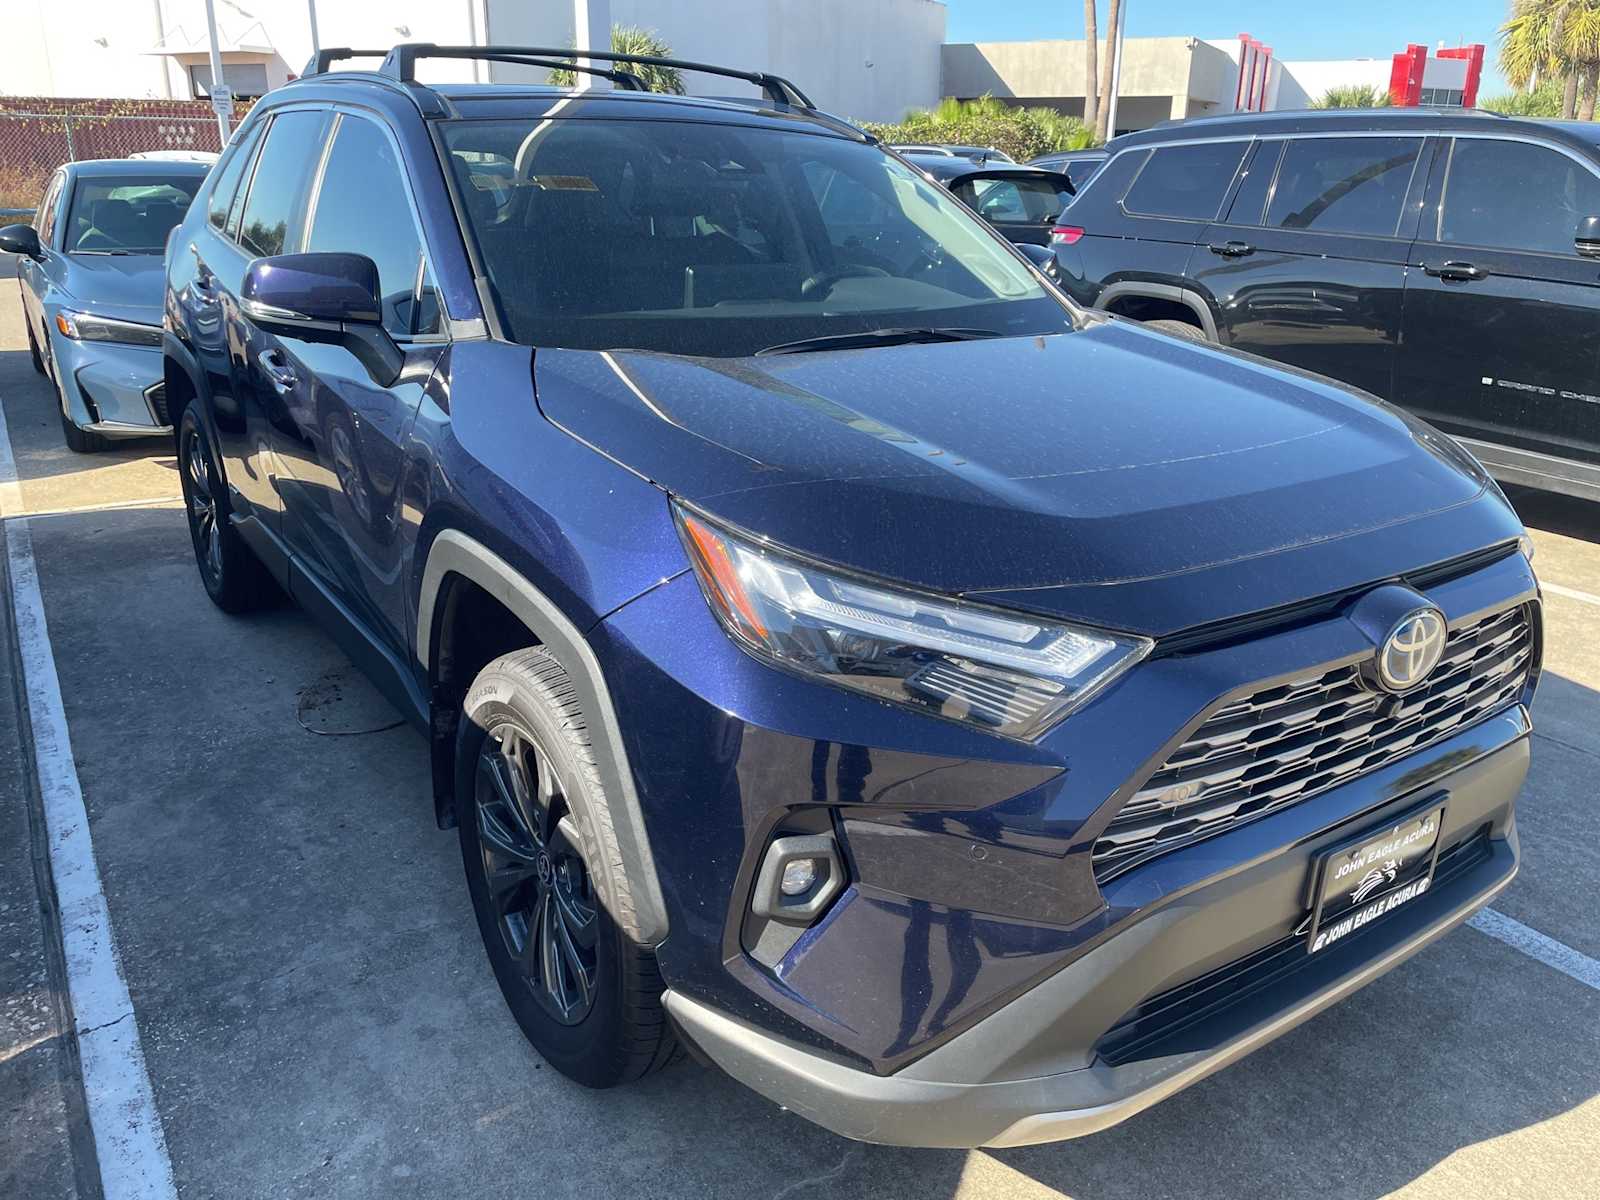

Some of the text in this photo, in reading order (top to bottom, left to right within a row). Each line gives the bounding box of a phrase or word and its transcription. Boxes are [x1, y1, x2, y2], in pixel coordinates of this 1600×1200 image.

[1335, 822, 1435, 880] JOHN EAGLE ACURA
[1325, 884, 1417, 945] JOHN EAGLE ACURA
